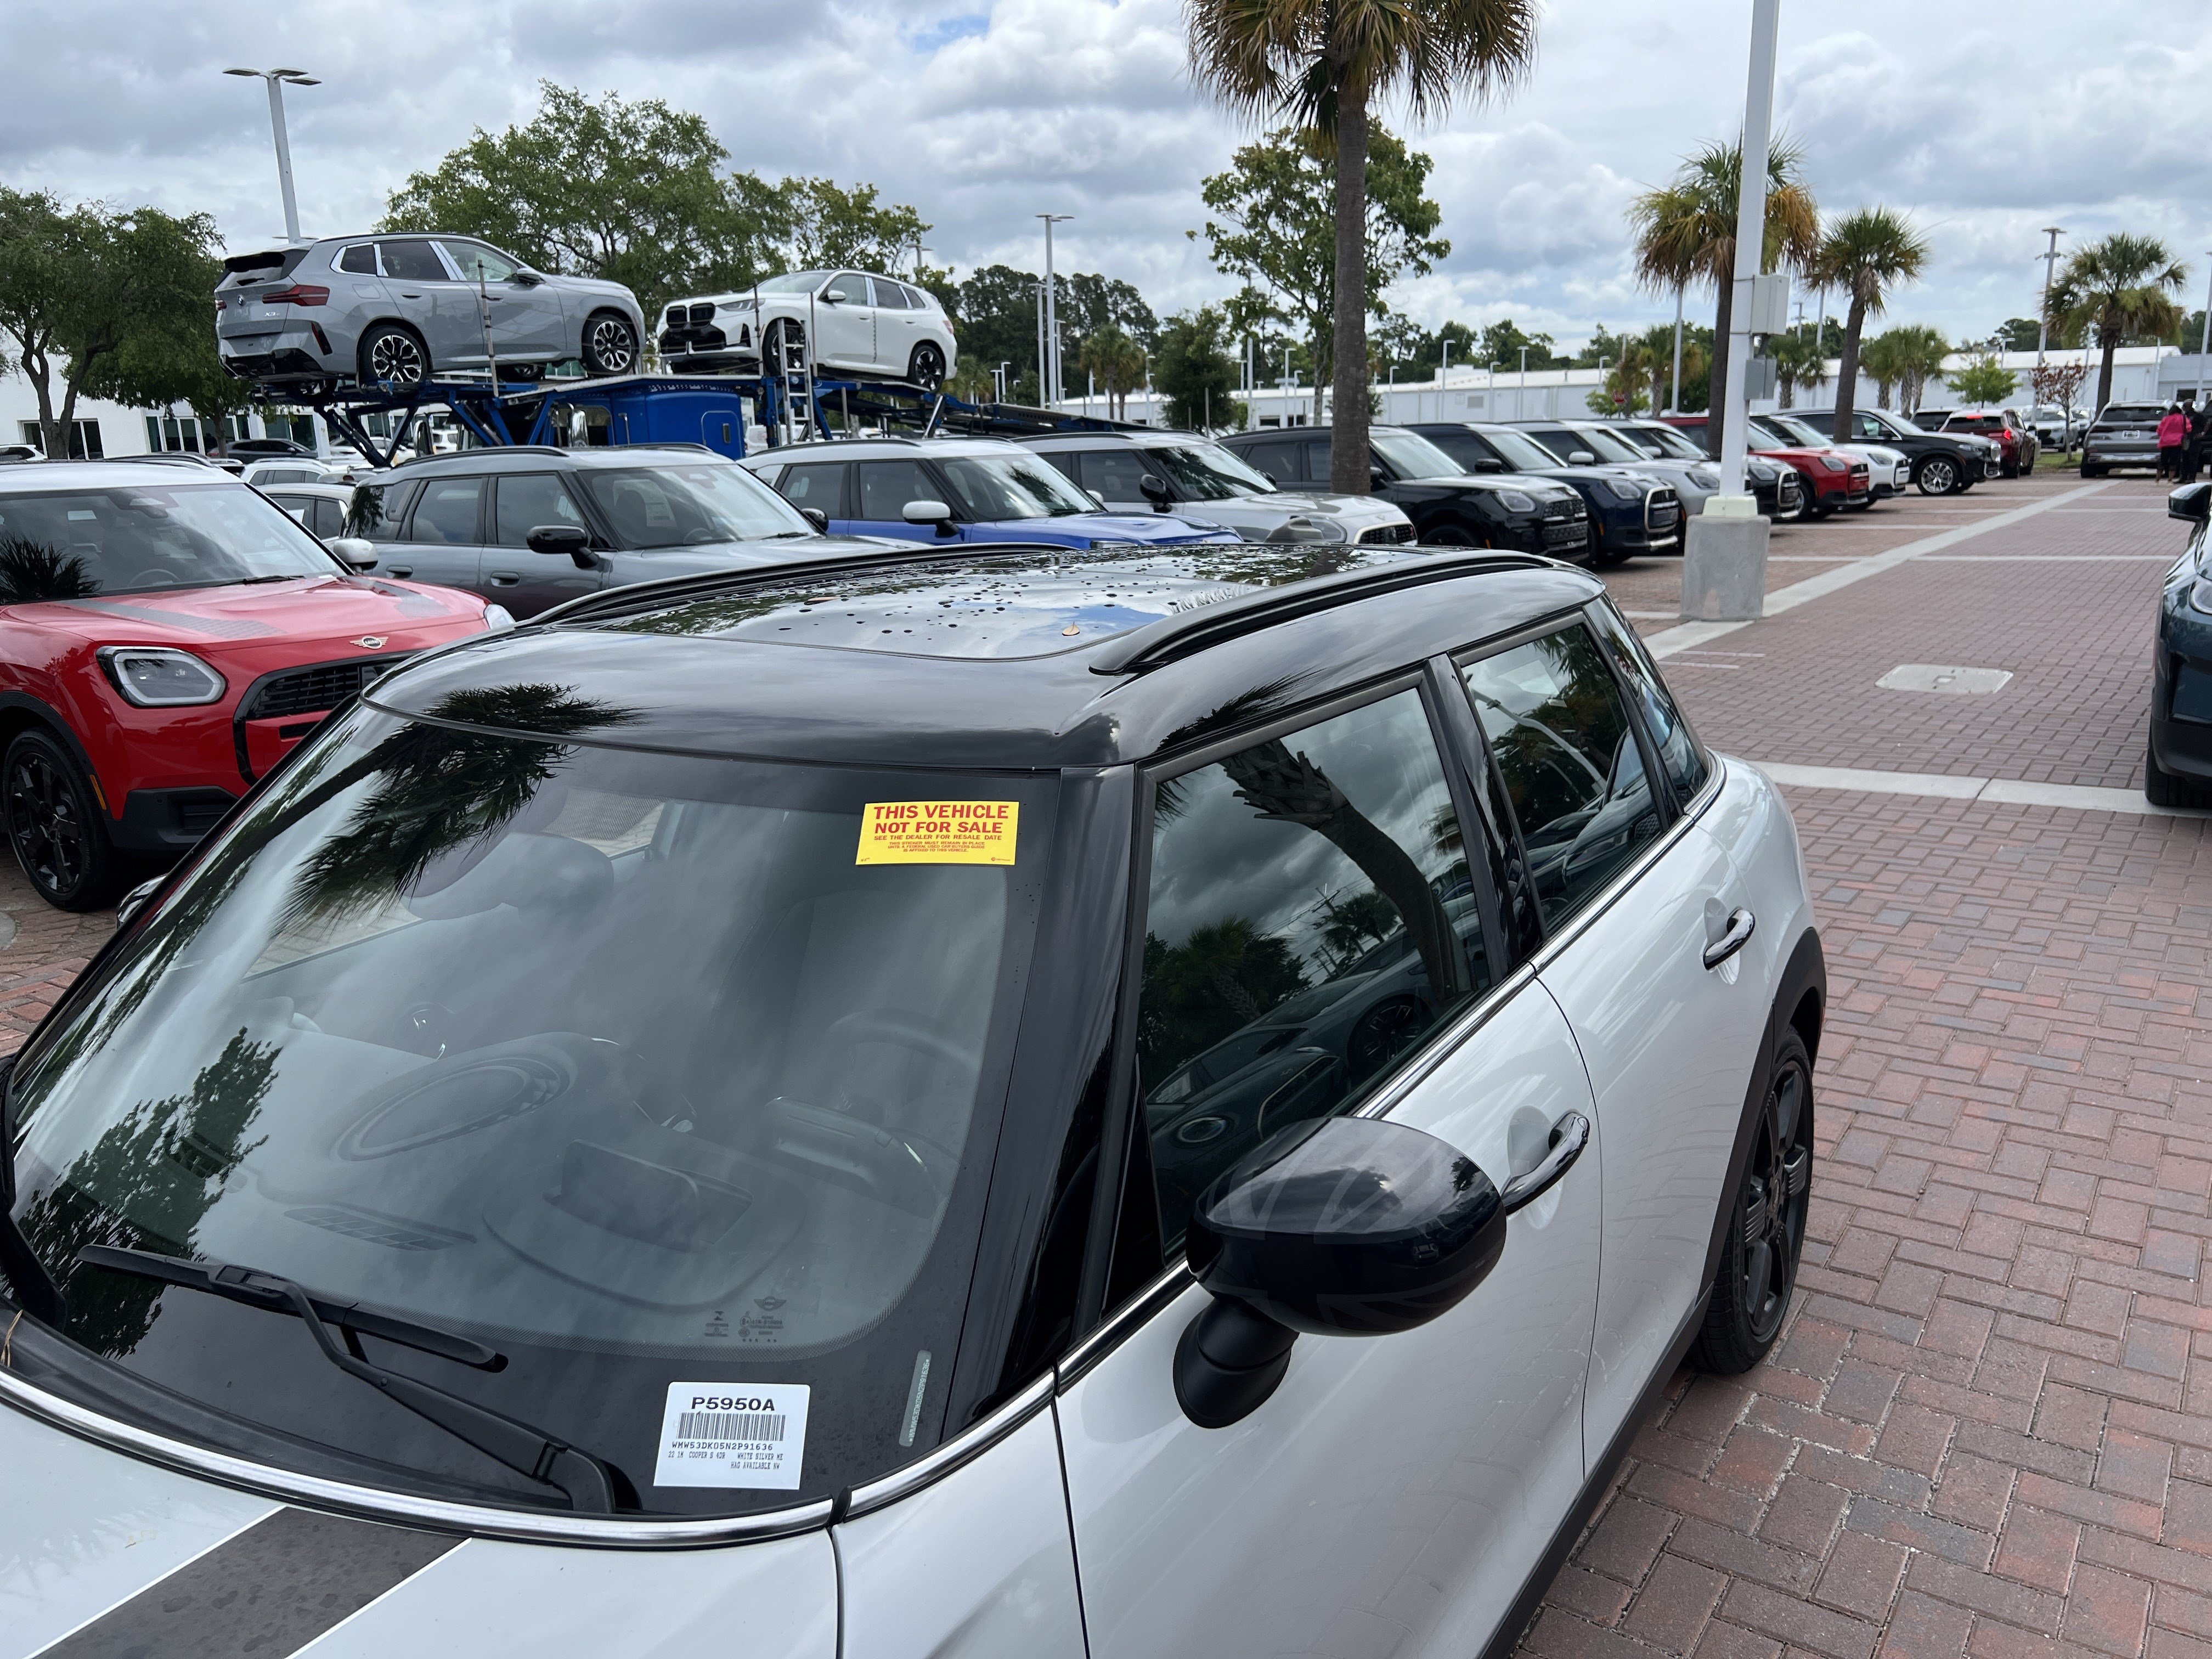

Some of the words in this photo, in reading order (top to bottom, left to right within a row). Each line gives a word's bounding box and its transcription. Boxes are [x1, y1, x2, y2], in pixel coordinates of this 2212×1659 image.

[874, 805, 918, 819] THIS
[924, 805, 1009, 819] VEHICLE
[874, 822, 910, 833] NOT
[915, 822, 951, 832] FOR
[957, 822, 1003, 833] SALE
[691, 1396, 775, 1411] P5950A
[672, 1441, 774, 1450] WMW53DK05N2P91636
